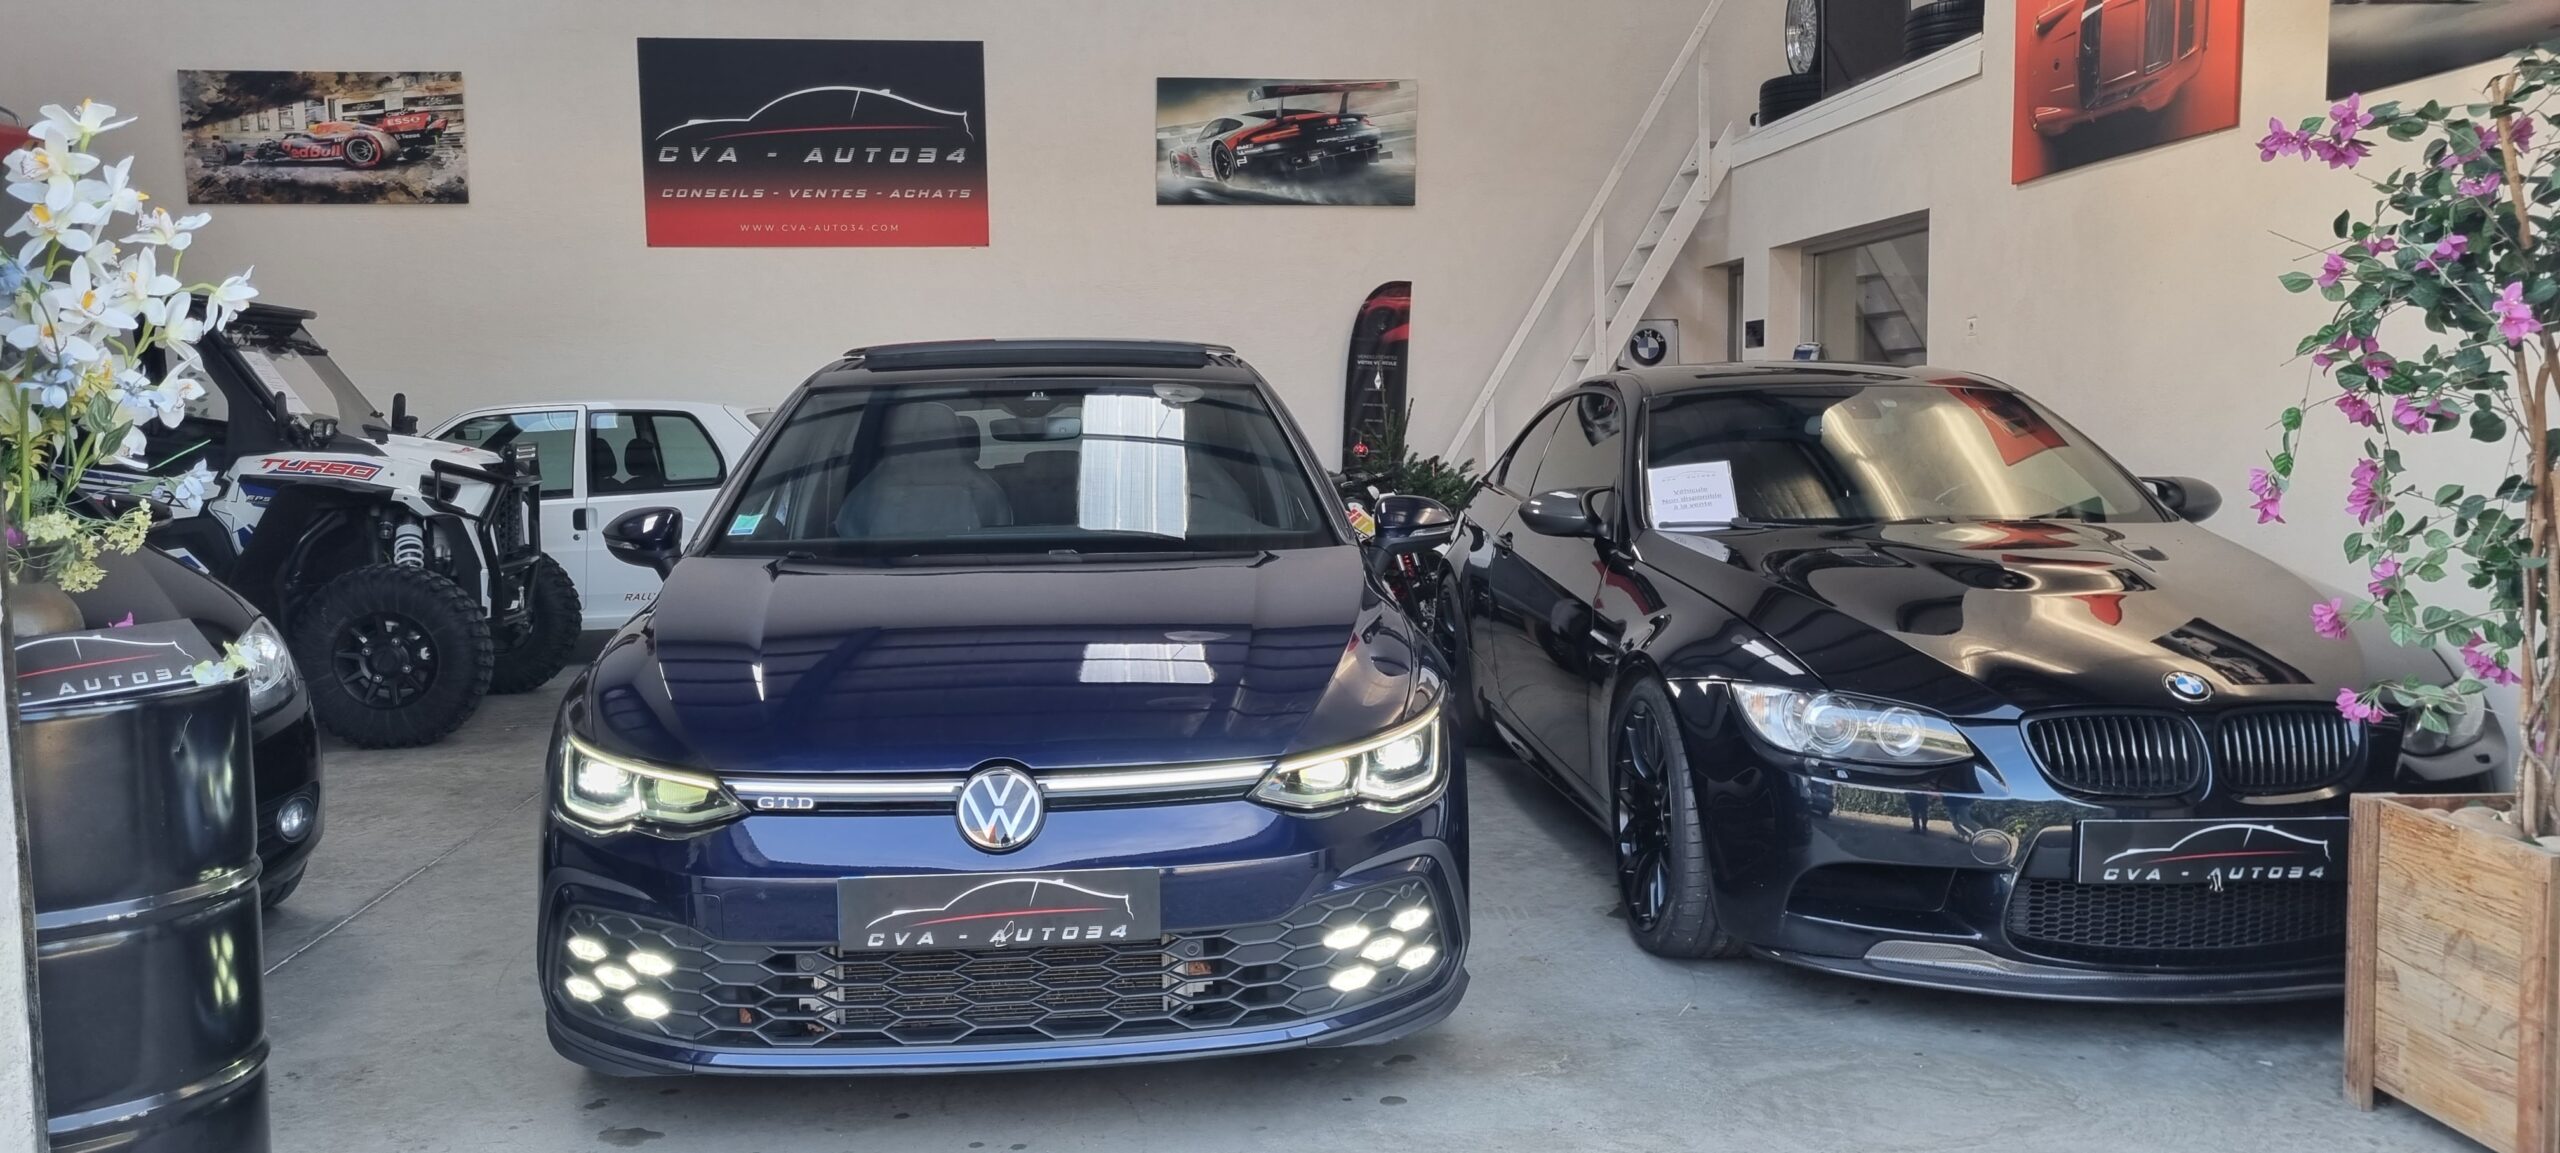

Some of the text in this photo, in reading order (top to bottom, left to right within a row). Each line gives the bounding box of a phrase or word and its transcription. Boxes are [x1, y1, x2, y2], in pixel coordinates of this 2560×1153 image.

[386, 116, 421, 127] ESSO
[657, 146, 739, 164] CVA
[803, 146, 967, 164] AUTO34
[661, 188, 766, 199] CONSEILS
[788, 188, 869, 199] VENTES
[888, 188, 973, 199] ACHATS
[739, 223, 900, 232] WWW.CVA-AUTO34.COM
[261, 458, 378, 481] TURBO
[624, 592, 657, 602] RALL
[58, 665, 194, 696] AUTO34
[757, 796, 815, 809] GTD
[2103, 868, 2161, 881] CVA
[2207, 866, 2325, 881] AUTO34
[867, 930, 935, 947] CVA
[989, 924, 1128, 946] AUTO34
